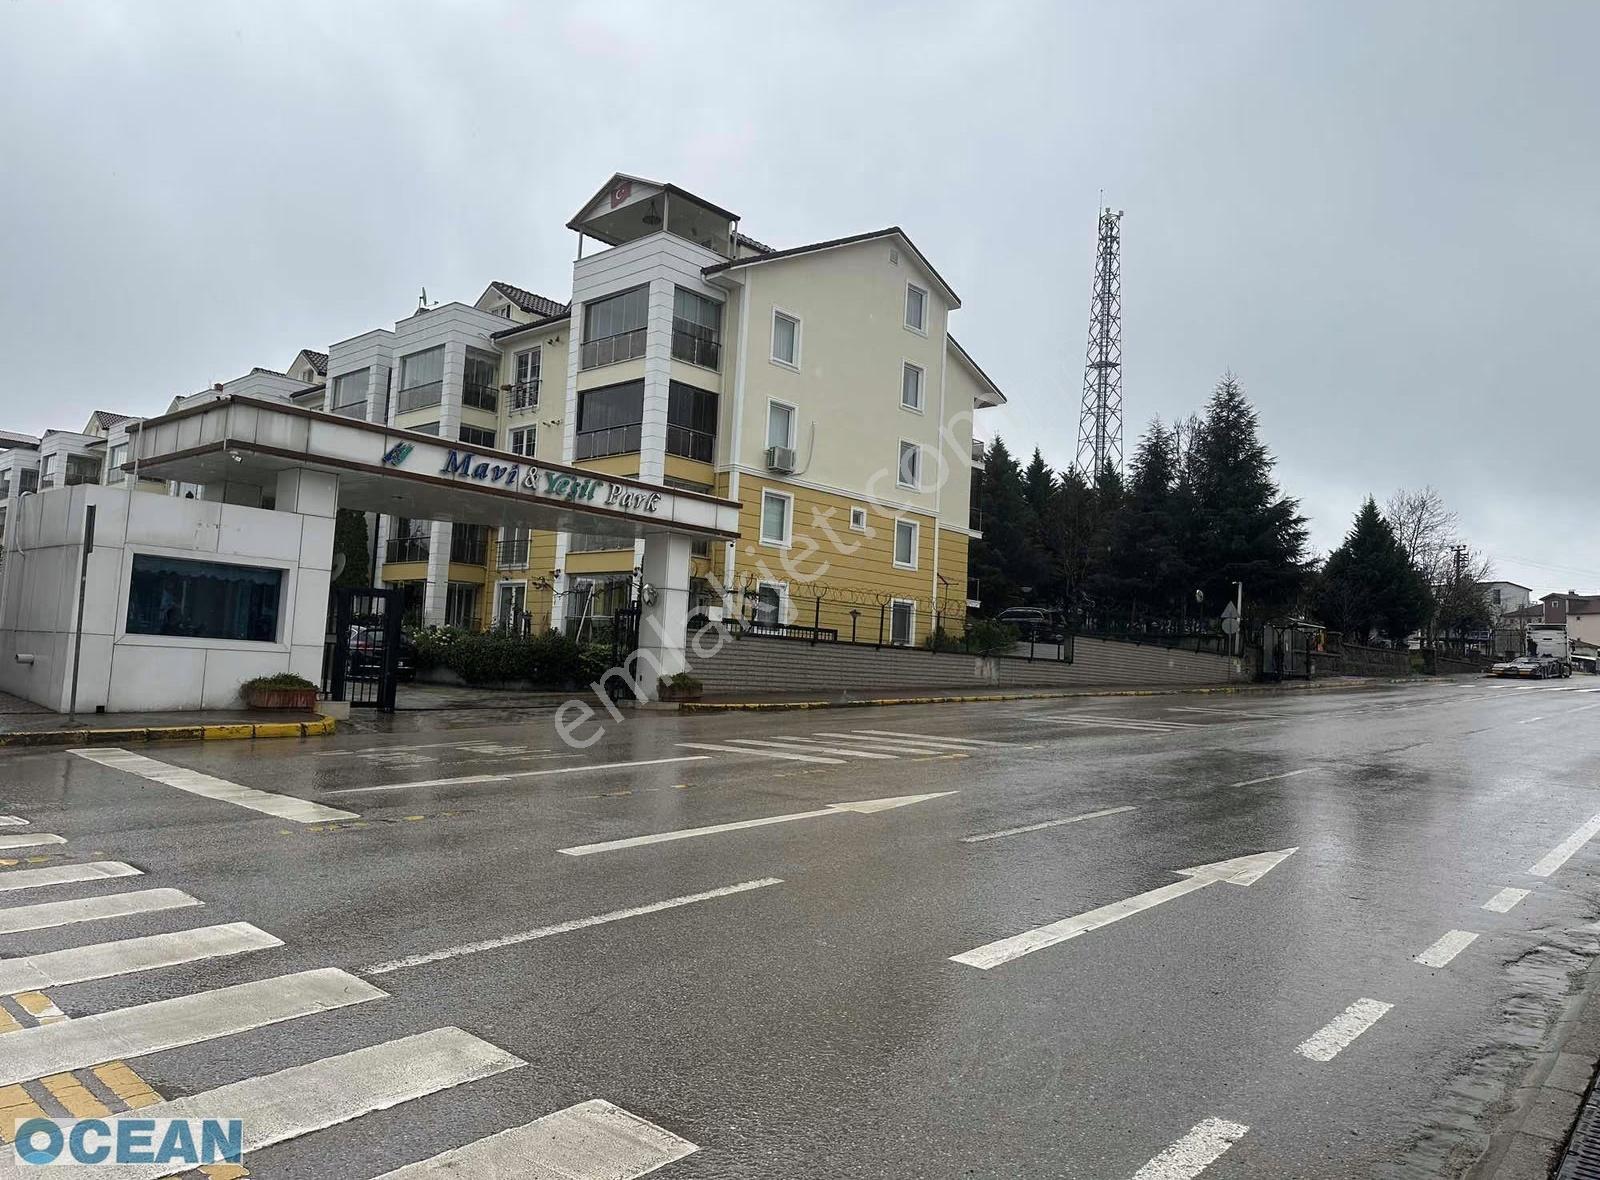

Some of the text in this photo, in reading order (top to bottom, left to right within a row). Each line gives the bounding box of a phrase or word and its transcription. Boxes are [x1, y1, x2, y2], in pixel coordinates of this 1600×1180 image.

[440, 447, 519, 485] Mavi
[522, 466, 542, 490] &
[605, 482, 662, 513] Park
